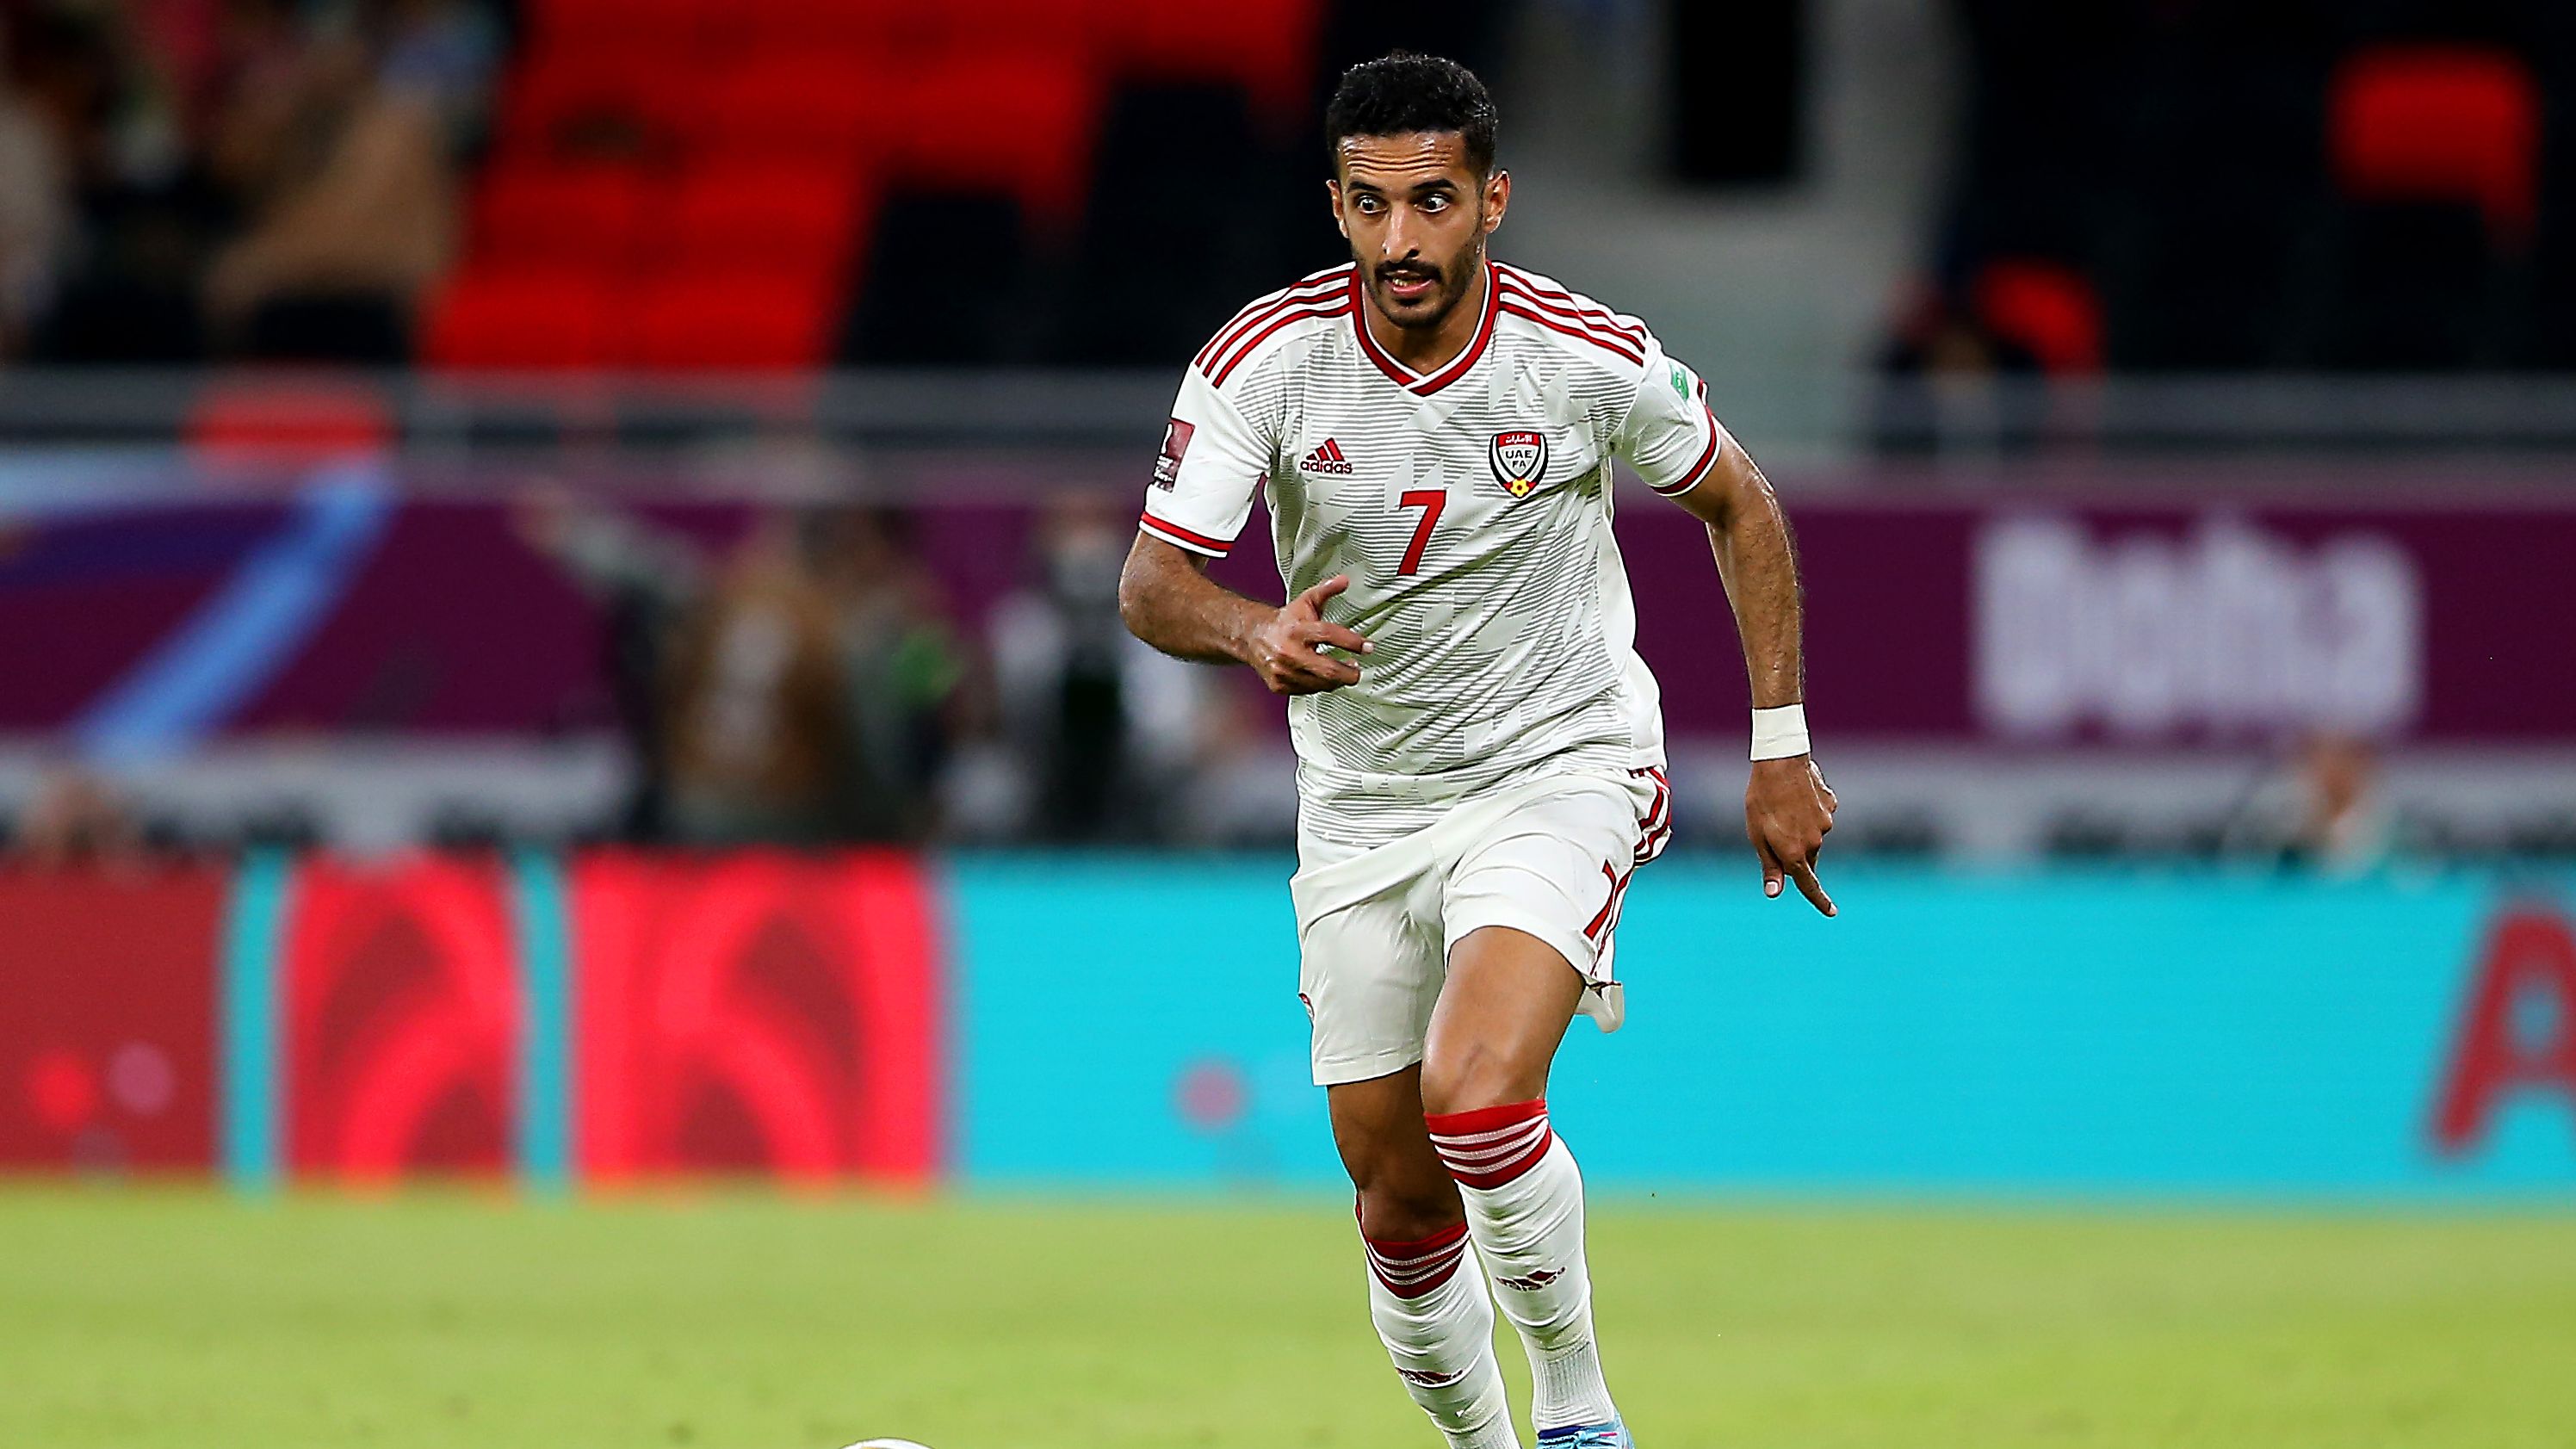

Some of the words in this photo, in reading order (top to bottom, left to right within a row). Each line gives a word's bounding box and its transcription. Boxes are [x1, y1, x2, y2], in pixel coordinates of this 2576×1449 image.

[1505, 449, 1533, 459] UAE
[1300, 460, 1353, 474] adidas
[1512, 460, 1526, 468] FA
[1397, 489, 1447, 577] 7
[1972, 517, 2424, 739] Doha
